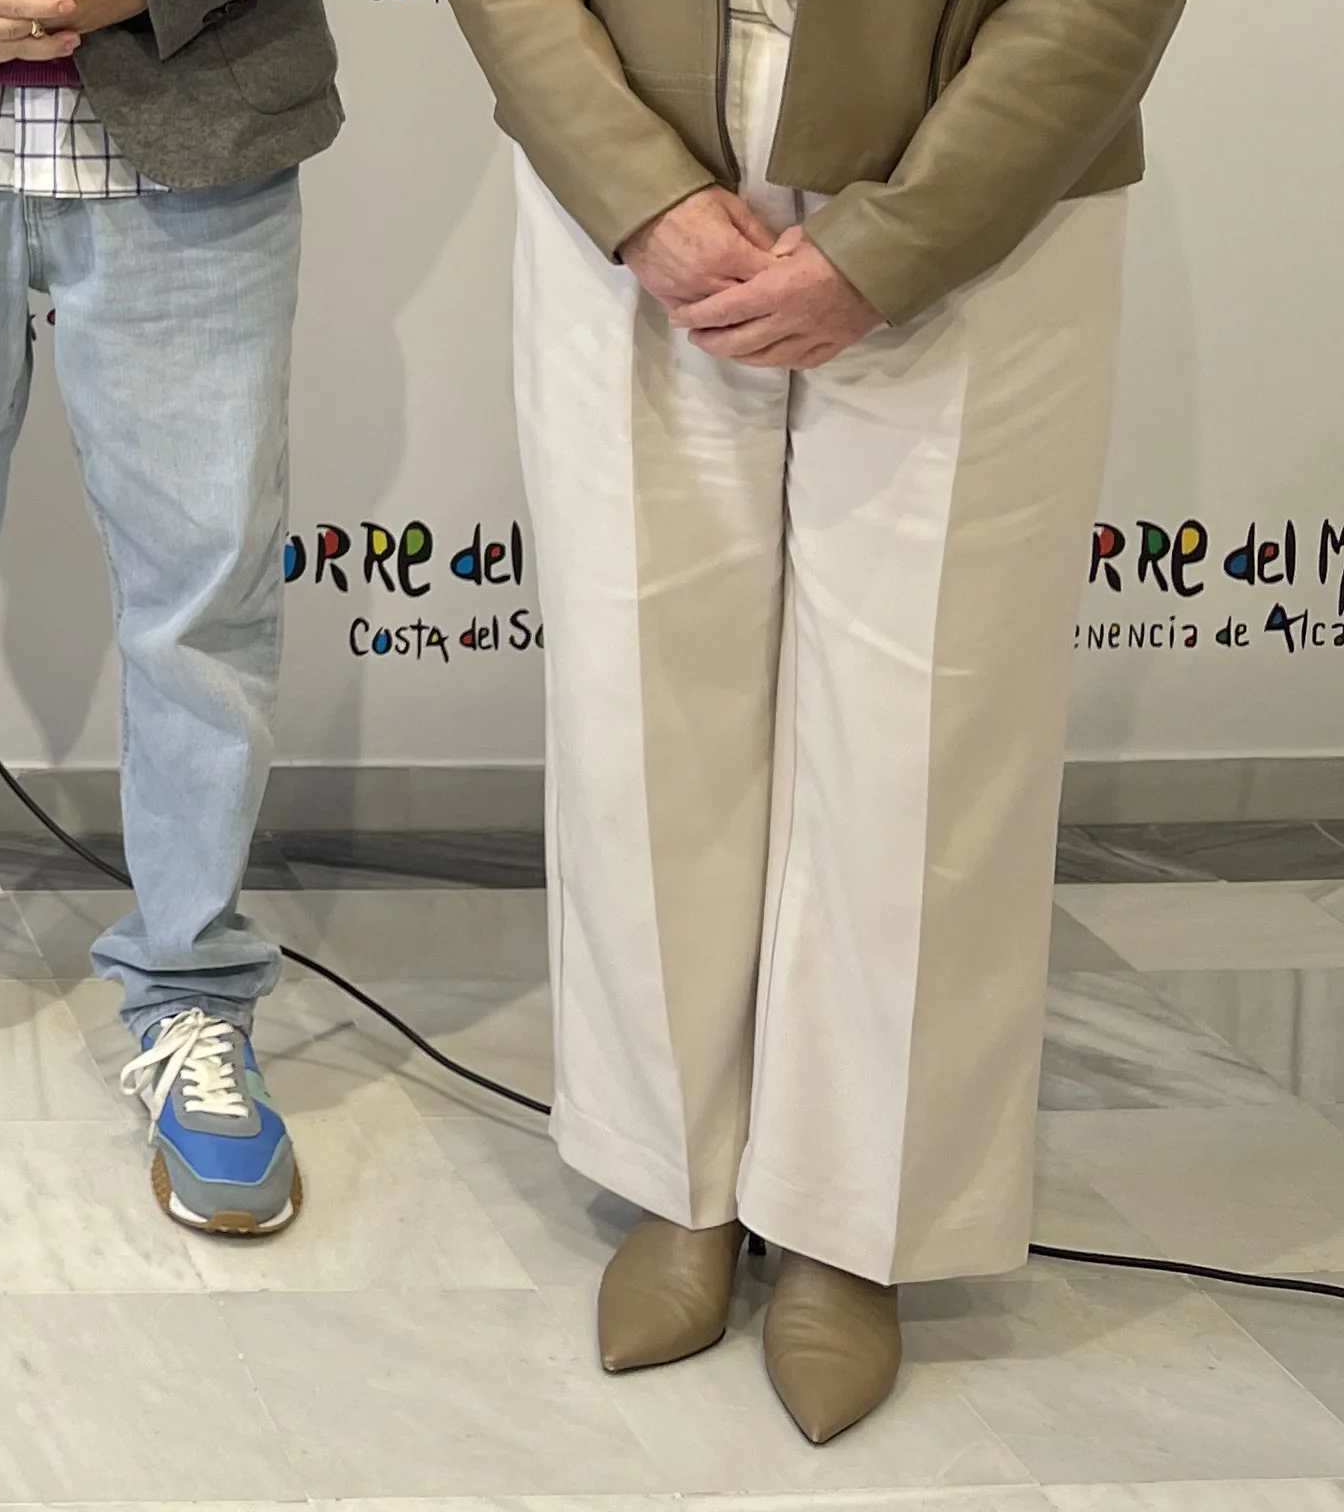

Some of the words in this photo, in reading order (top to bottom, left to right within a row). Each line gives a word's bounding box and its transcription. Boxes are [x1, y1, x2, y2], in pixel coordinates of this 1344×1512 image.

[450, 522, 522, 585] del
[1224, 520, 1295, 585] del
[460, 616, 498, 650] del
